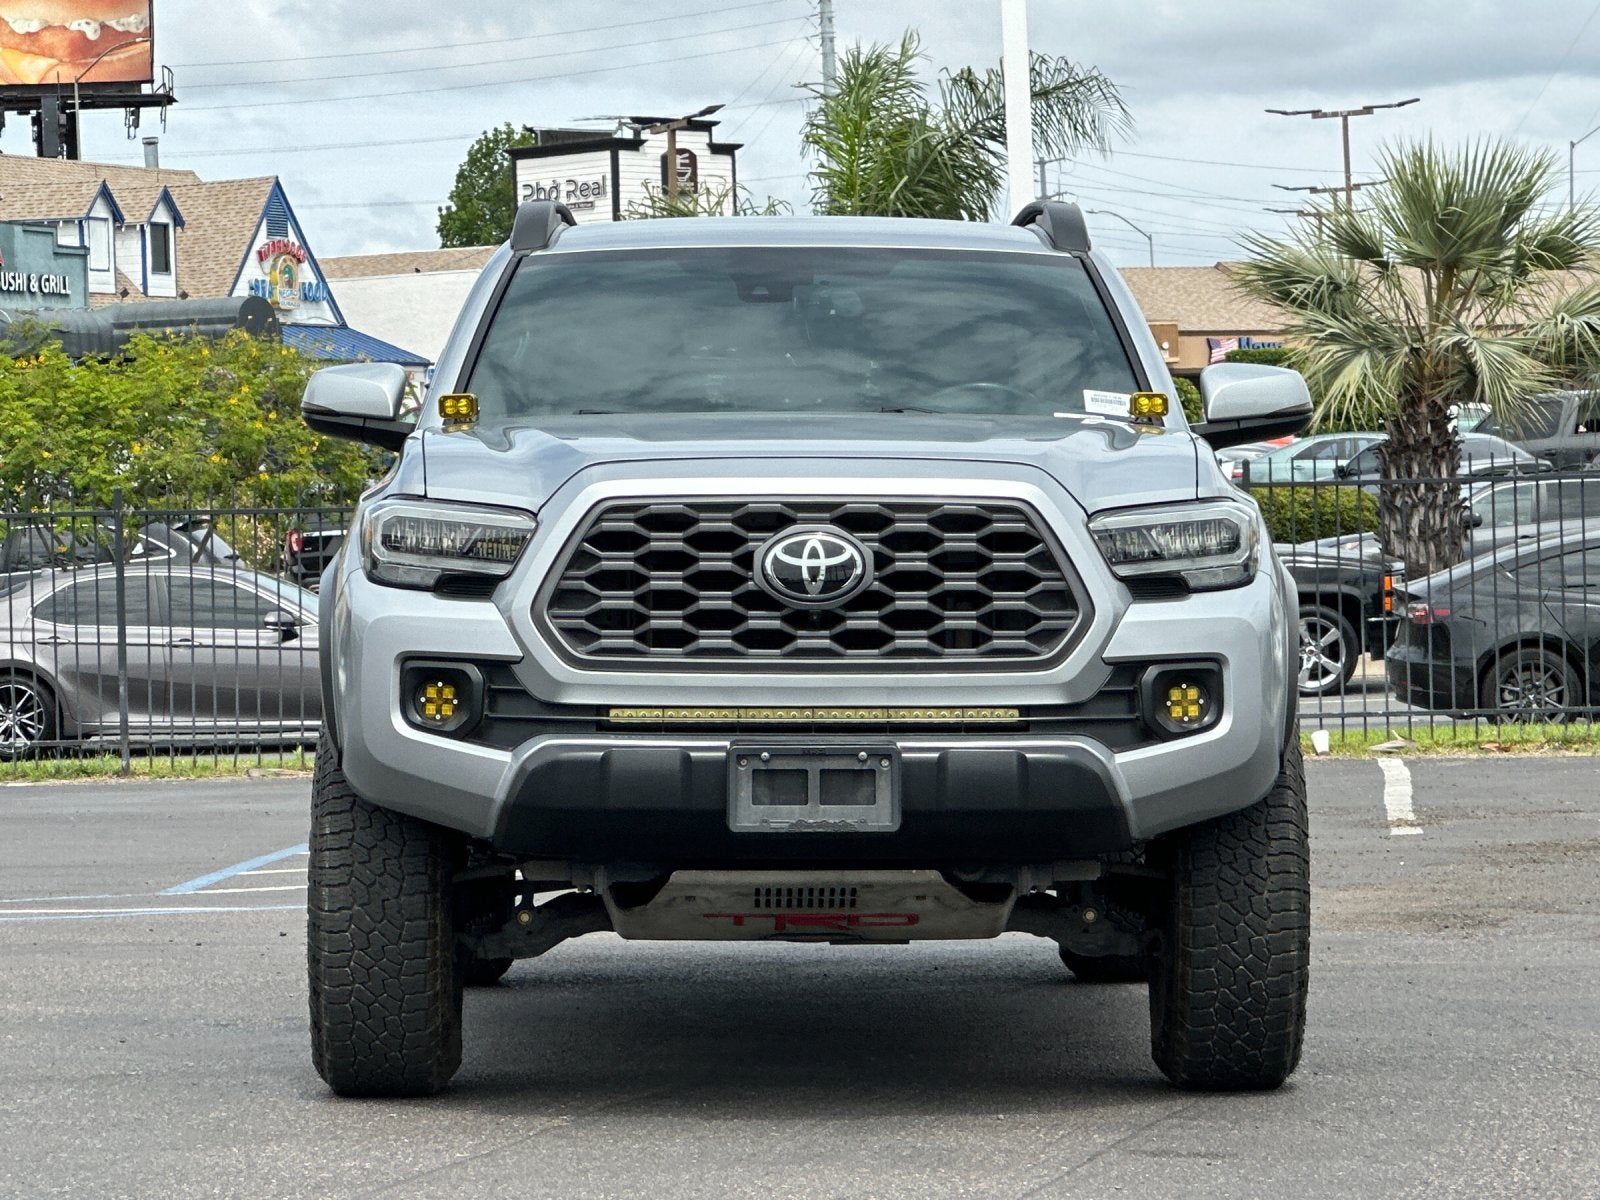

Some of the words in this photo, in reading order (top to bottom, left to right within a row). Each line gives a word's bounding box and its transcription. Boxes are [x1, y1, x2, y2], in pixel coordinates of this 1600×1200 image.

[565, 174, 607, 200] Real
[29, 273, 39, 293] &
[41, 274, 72, 295] GRILL
[301, 281, 328, 302] FOOD
[703, 912, 919, 932] TRD
